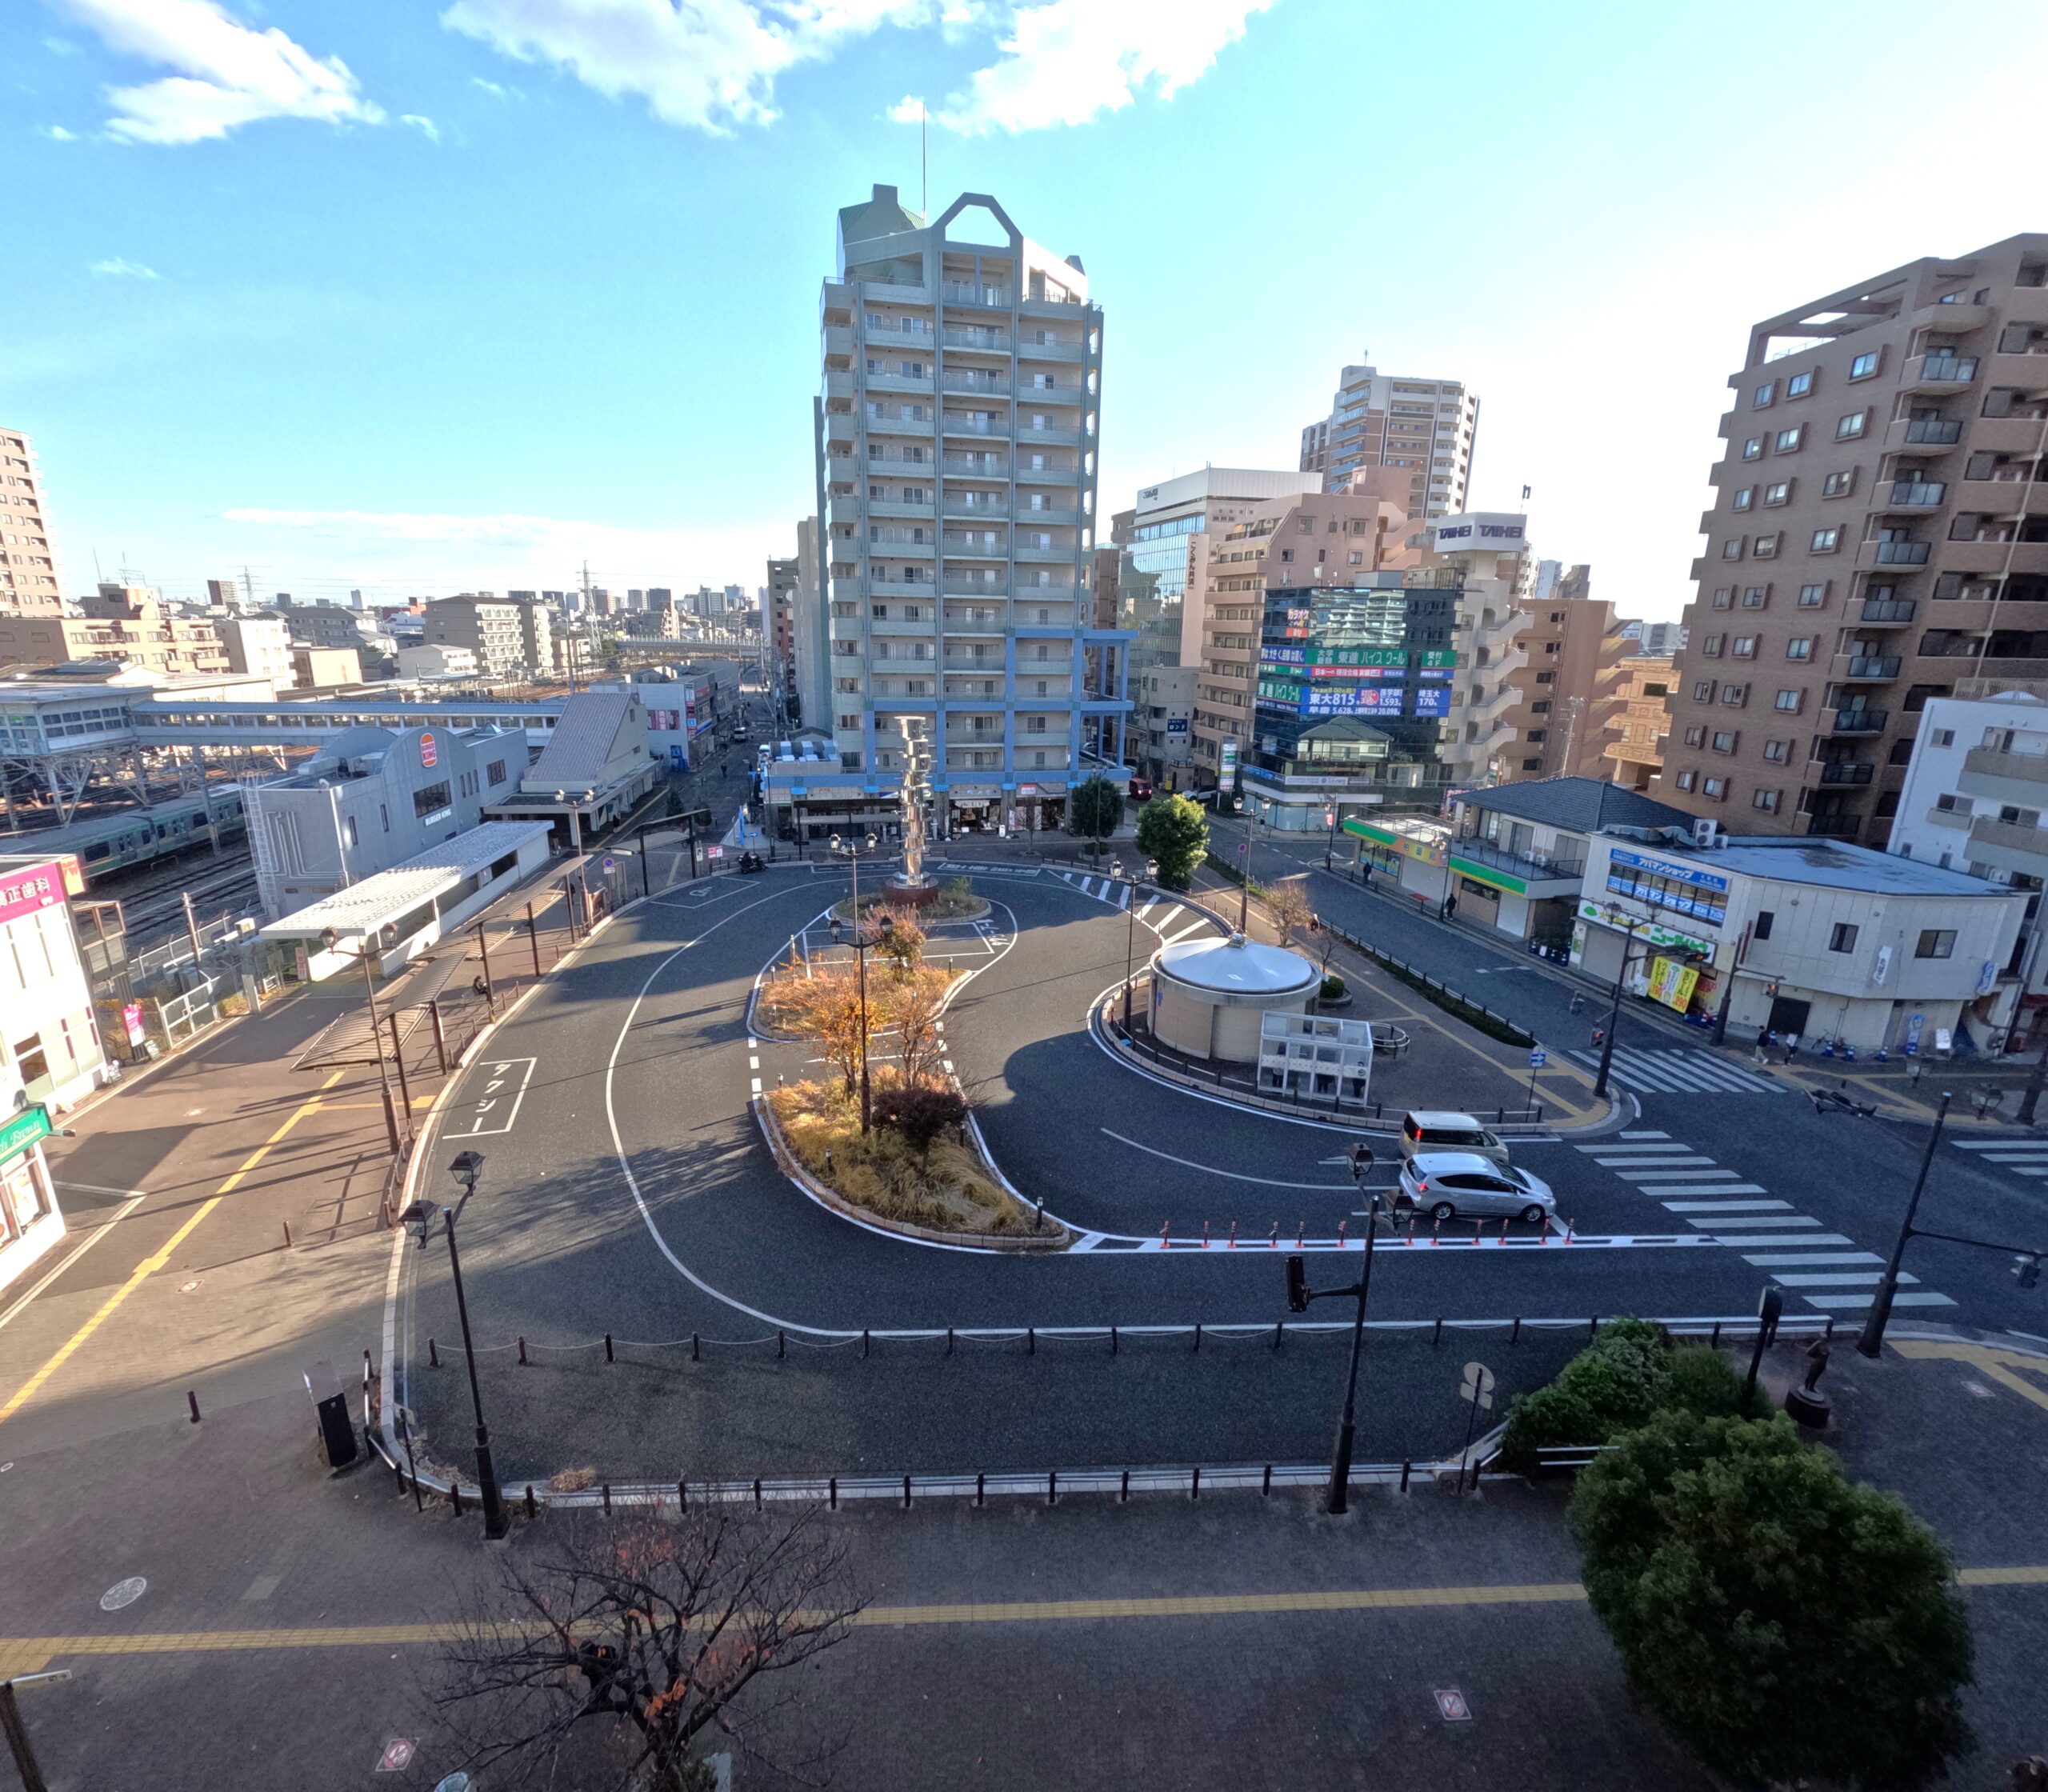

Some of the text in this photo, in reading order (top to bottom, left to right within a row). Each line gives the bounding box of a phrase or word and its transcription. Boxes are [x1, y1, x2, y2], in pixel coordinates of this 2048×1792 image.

[1287, 609, 1310, 620] カラオケ
[1638, 857, 1694, 878] アパマンショップ
[1635, 886, 1692, 909] アパマンショップ
[471, 1063, 512, 1133] タクシー
